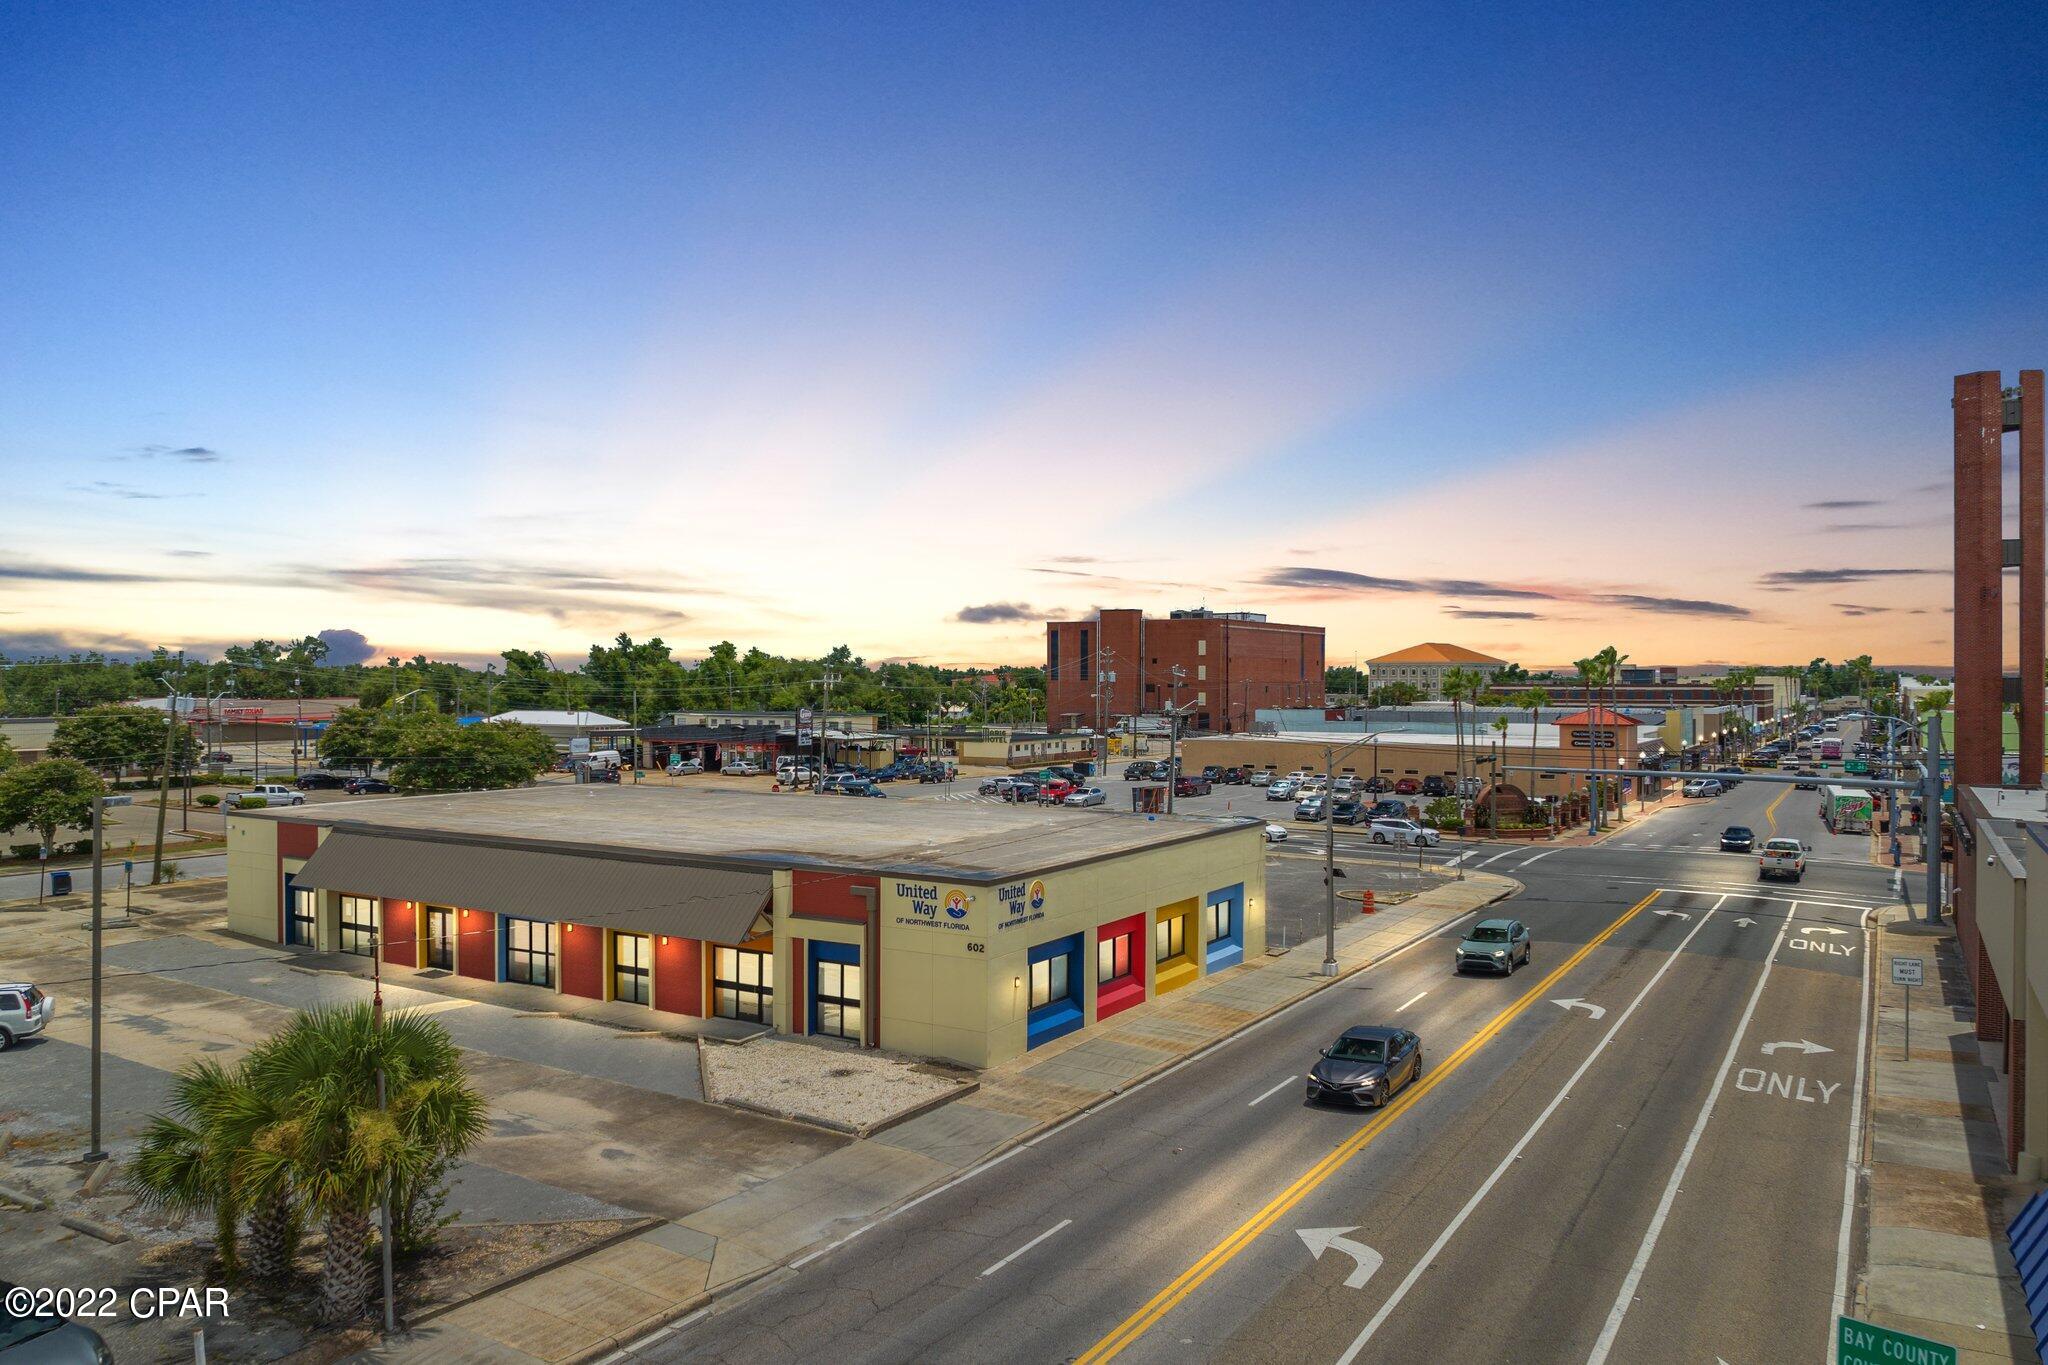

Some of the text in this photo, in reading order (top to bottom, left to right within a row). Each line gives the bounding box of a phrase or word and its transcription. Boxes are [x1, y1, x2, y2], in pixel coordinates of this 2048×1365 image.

[896, 883, 938, 900] United
[999, 882, 1026, 902] United
[912, 900, 938, 920] Way
[1009, 900, 1026, 916] Way
[1029, 911, 1045, 921] FLORIDA
[905, 919, 942, 928] NORTHWEST
[943, 922, 970, 931] FLORIDA
[967, 943, 985, 954] 602
[1789, 938, 1856, 957] ONLY
[1736, 1067, 1842, 1105] ONLY
[1844, 1327, 1875, 1351] BAY
[1882, 1338, 1950, 1365] COUNTY
